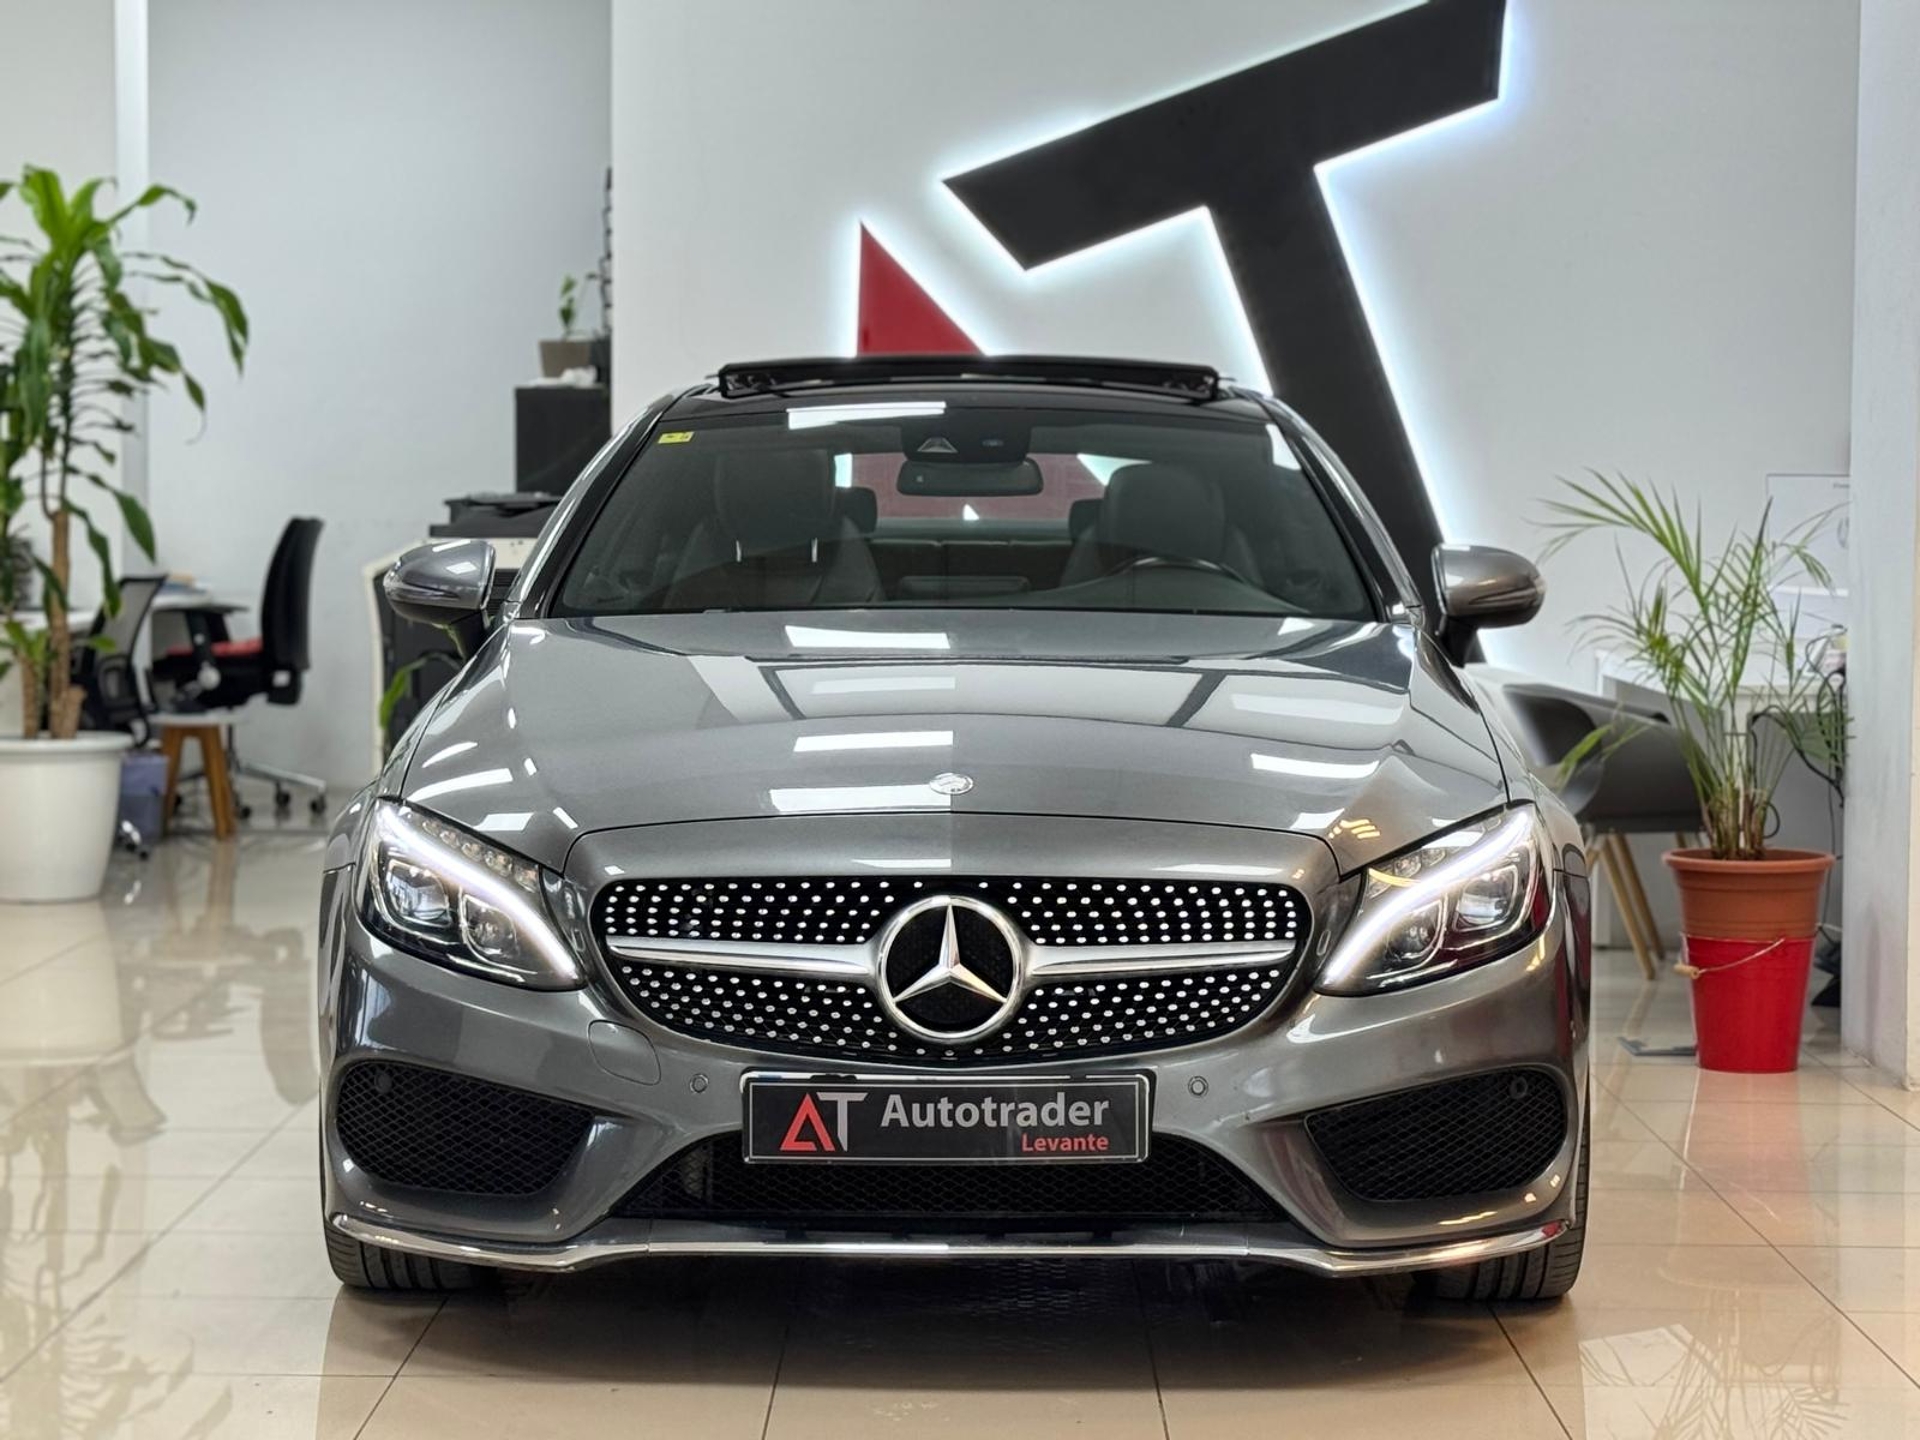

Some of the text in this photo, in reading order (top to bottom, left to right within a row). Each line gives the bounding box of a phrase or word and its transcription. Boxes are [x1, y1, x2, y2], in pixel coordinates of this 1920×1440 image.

[780, 1092, 868, 1152] AT
[880, 1092, 1109, 1128] Autotrader
[1021, 1133, 1109, 1153] Levante
